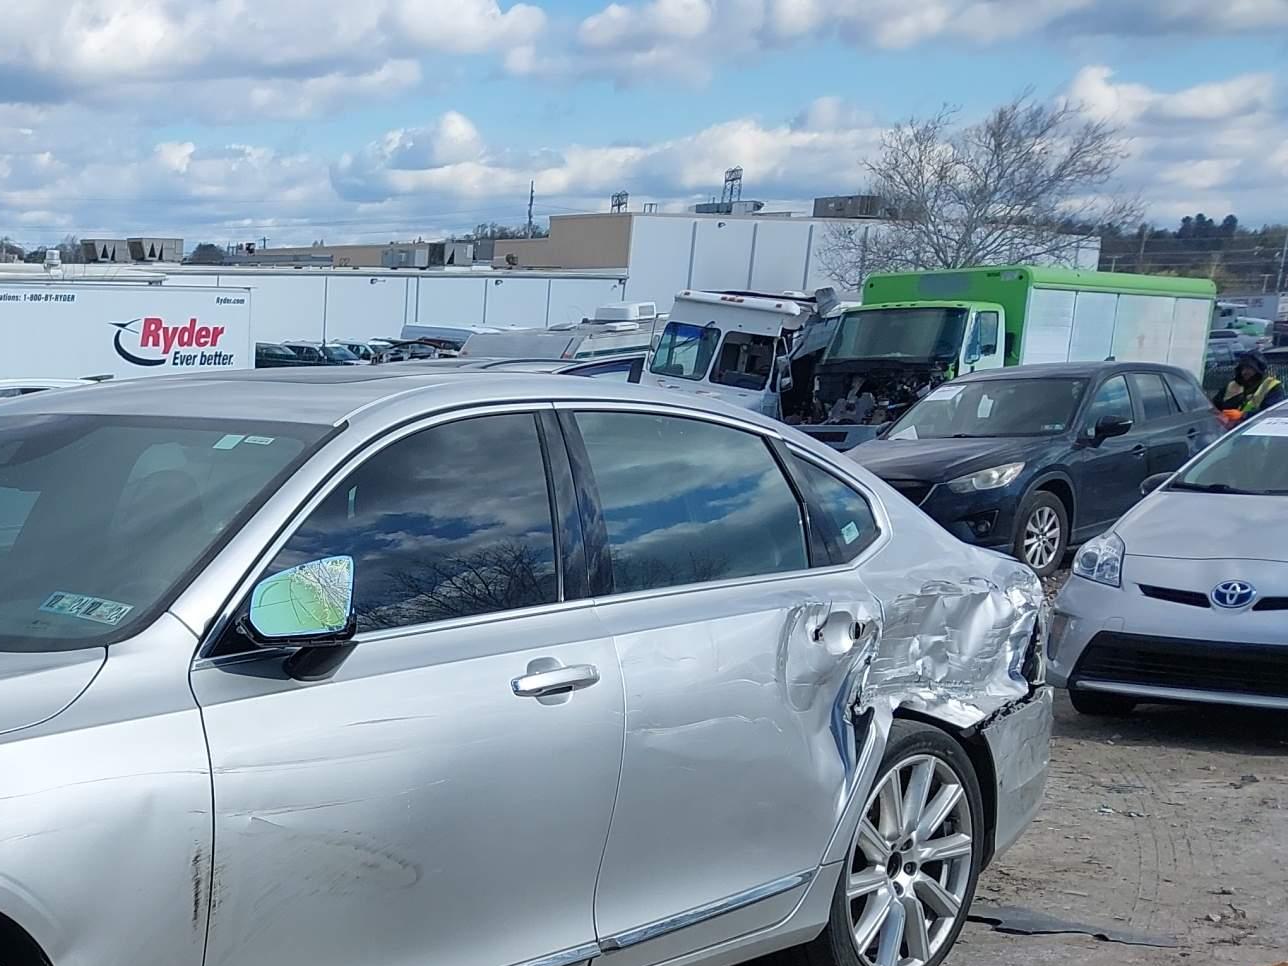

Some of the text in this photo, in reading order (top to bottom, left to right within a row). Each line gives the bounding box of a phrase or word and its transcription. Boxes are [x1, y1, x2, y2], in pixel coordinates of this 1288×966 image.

[215, 296, 245, 305] Ryder.com
[140, 317, 225, 355] Ryder
[172, 351, 234, 366] Ever better.
